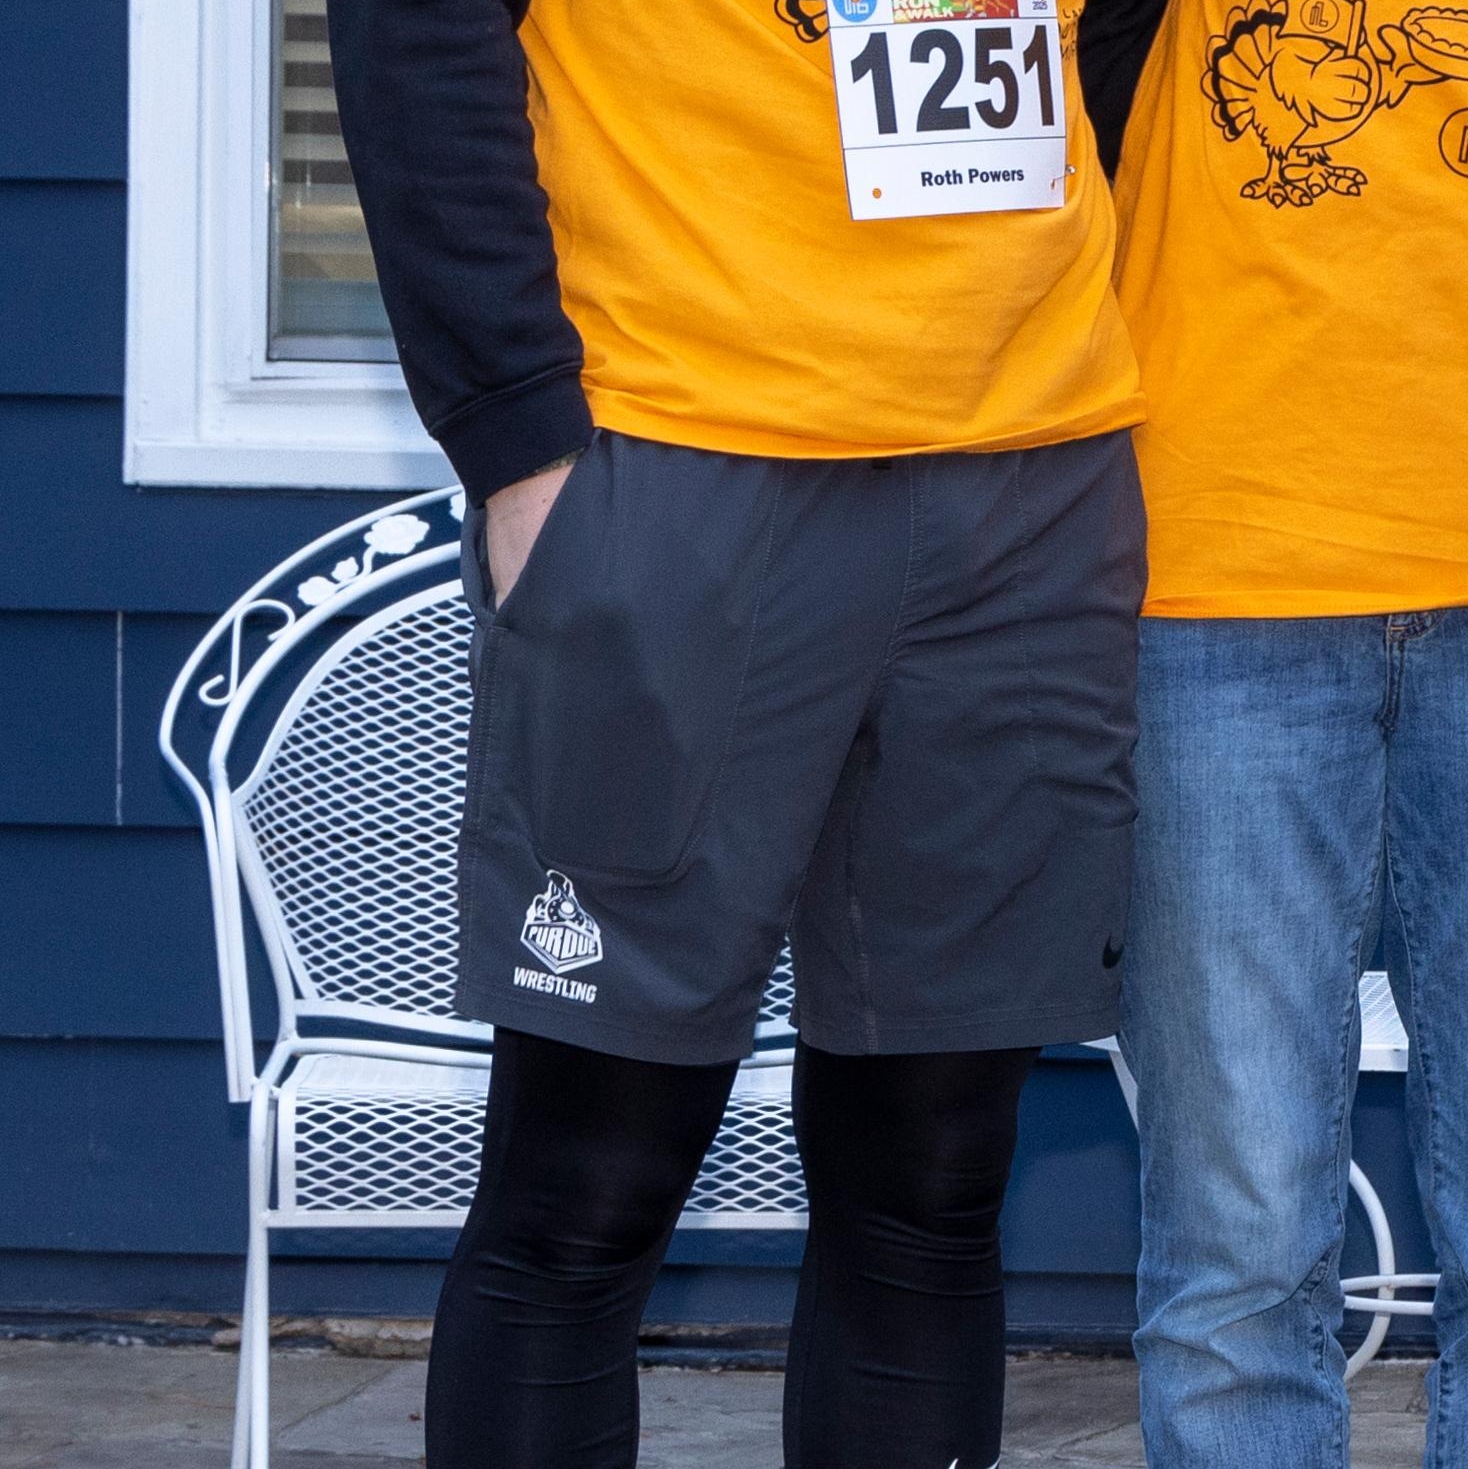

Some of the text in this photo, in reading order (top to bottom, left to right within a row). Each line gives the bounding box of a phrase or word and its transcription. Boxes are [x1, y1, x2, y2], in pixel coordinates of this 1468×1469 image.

[850, 24, 1055, 134] 1251
[921, 168, 1024, 187] Roth Powers
[528, 925, 598, 960] PURDUE
[513, 966, 598, 1004] WRESTLING
